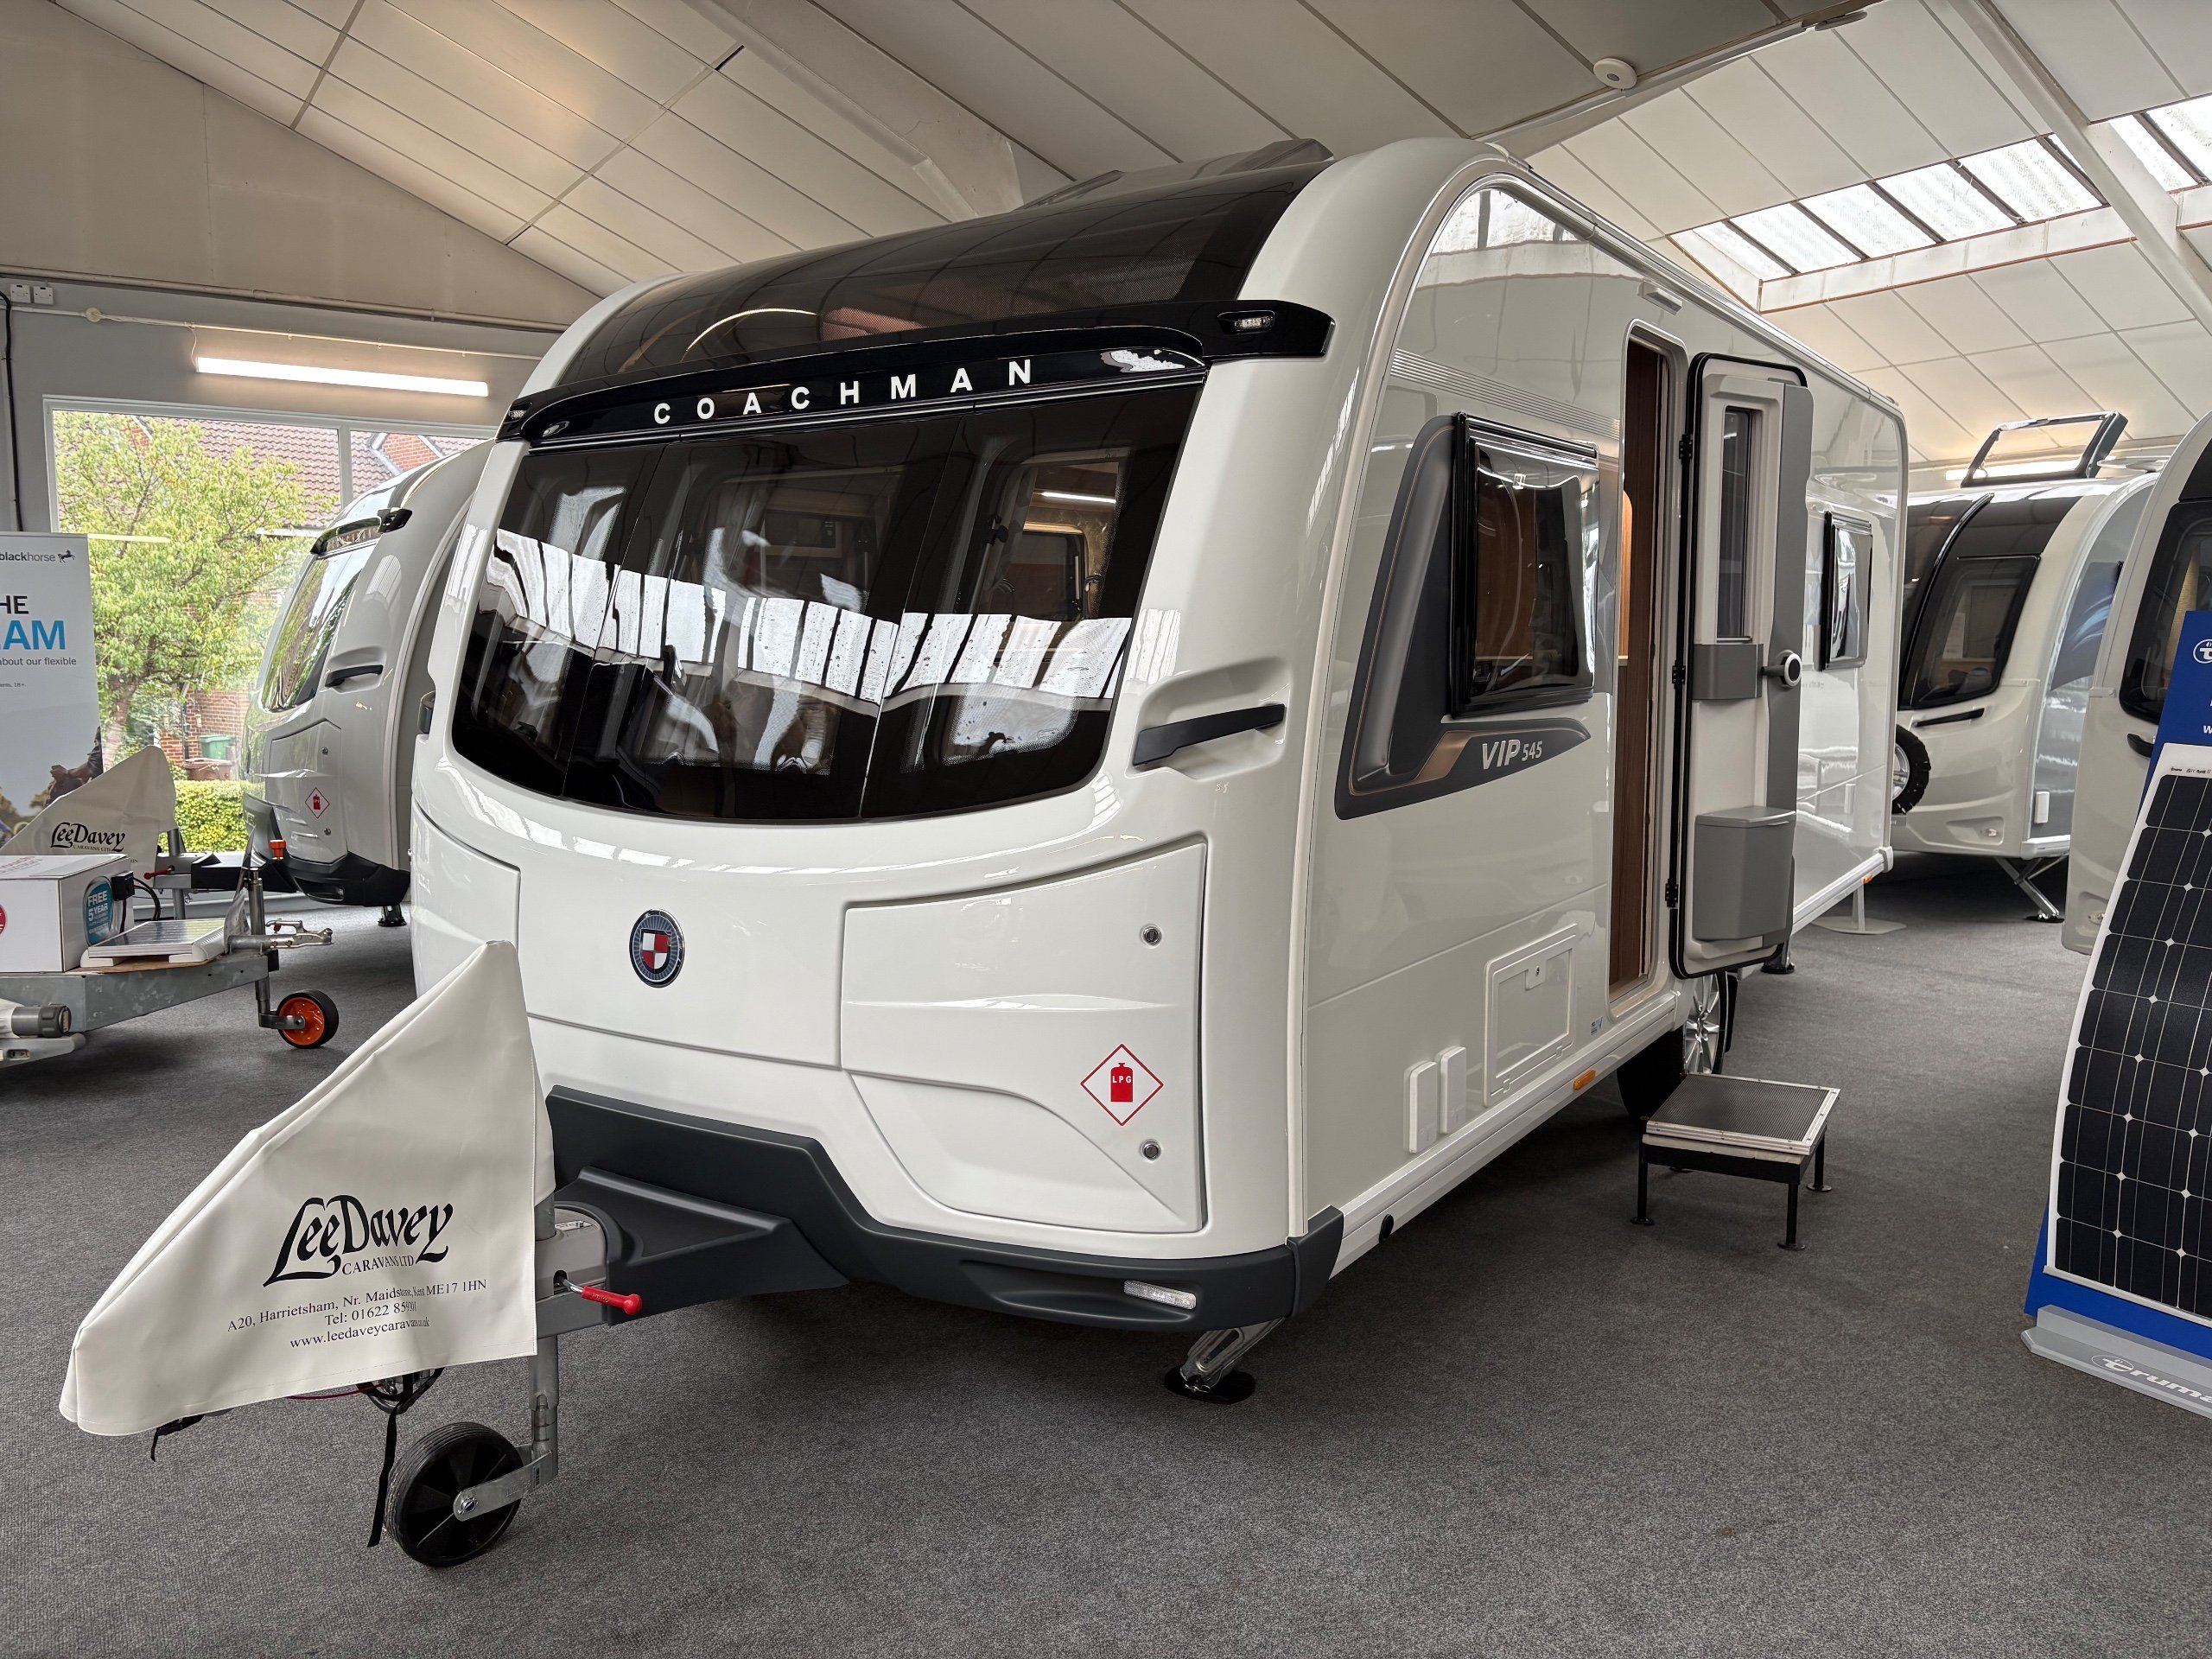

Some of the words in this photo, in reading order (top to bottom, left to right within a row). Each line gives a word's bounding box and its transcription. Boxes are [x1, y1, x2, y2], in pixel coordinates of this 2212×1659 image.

[653, 359, 1032, 424] COACHMAN
[44, 657, 77, 665] flexible
[1482, 739, 1521, 770] VIP
[1522, 741, 1543, 761] 545
[87, 890, 108, 907] FREE
[88, 908, 94, 922] 5
[93, 903, 109, 915] YEAR
[1112, 1075, 1132, 1084] LPG
[227, 1316, 256, 1332] A20,
[259, 1301, 339, 1324] Harrietsham,
[342, 1295, 361, 1307] Nr.
[426, 1282, 458, 1296] ME17
[462, 1279, 486, 1292] 1HN
[324, 1313, 347, 1326] Tel:
[351, 1305, 390, 1321] 01622
